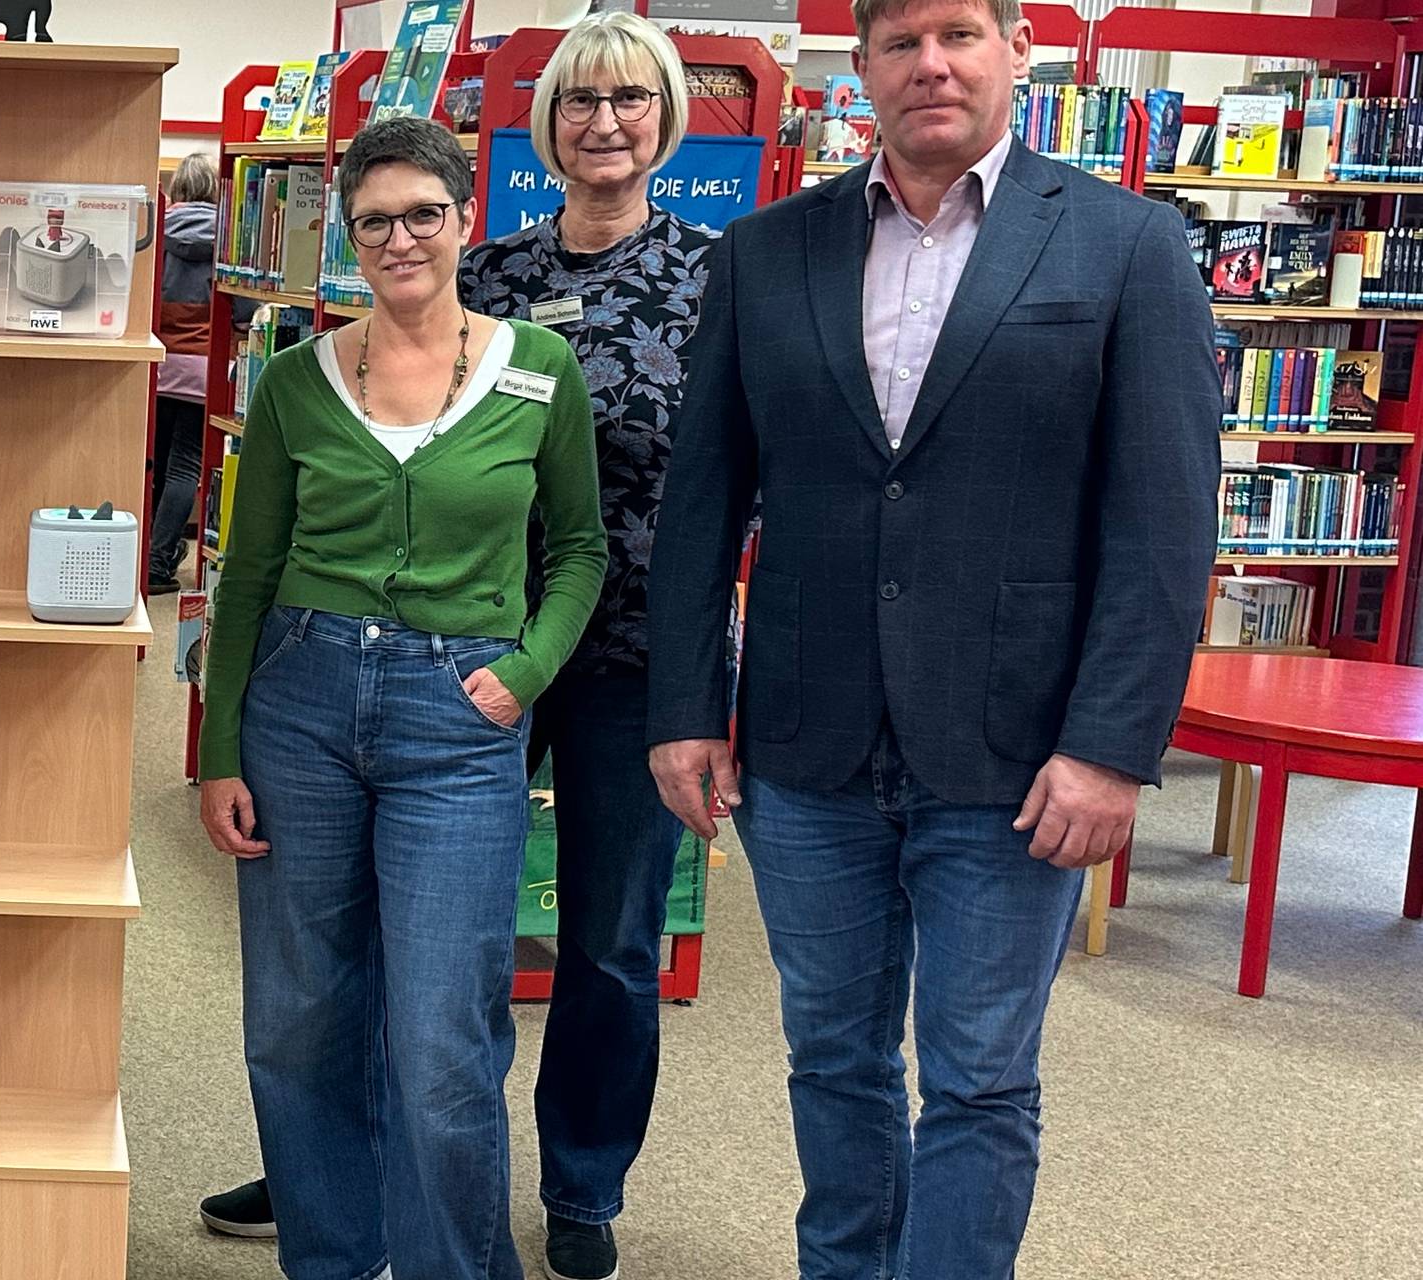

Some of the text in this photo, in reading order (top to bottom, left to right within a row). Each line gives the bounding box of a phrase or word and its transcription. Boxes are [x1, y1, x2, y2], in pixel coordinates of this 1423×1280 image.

[297, 171, 319, 183] The
[297, 185, 323, 196] Cam
[509, 170, 535, 192] ICH
[653, 177, 682, 198] DIE
[691, 177, 743, 203] WELT,
[77, 200, 118, 211] Toniebox
[120, 201, 128, 211] 2
[296, 199, 307, 209] to
[1220, 234, 1261, 252] HAWK
[30, 319, 59, 329] RWE
